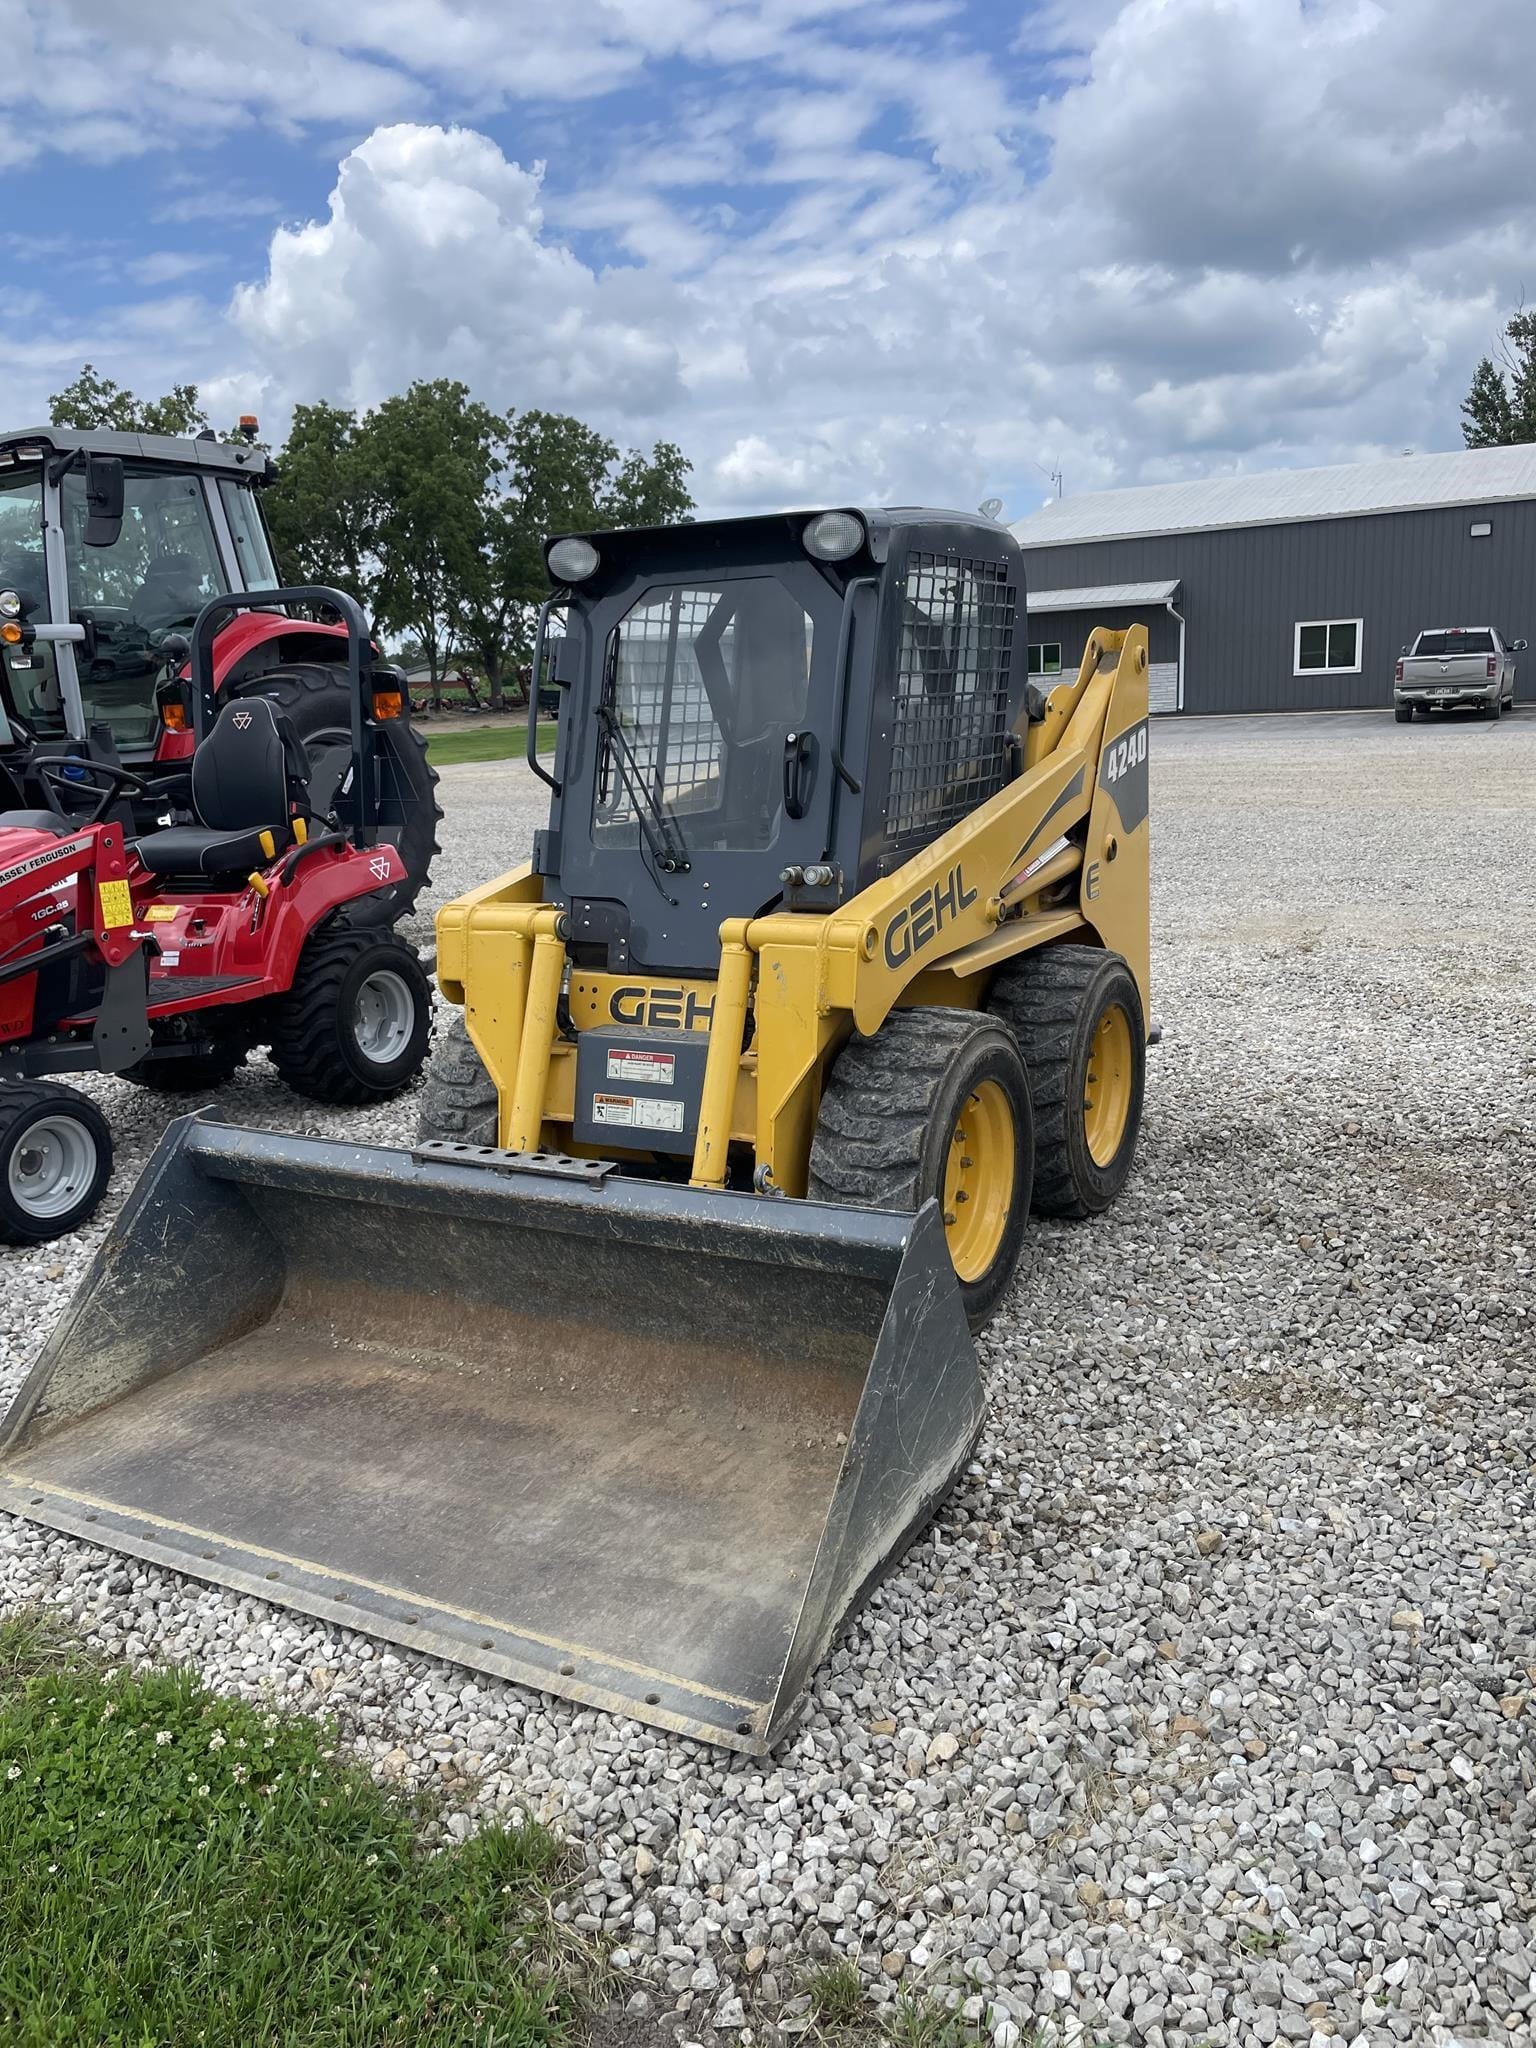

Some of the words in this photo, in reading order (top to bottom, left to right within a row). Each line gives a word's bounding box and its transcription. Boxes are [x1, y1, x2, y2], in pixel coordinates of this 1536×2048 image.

[1108, 727, 1147, 783] 4240
[0, 864, 27, 884] ASSEY
[30, 844, 76, 869] FERGUSON
[884, 861, 978, 970] GEHL
[1, 1020, 25, 1034] WD
[609, 987, 717, 1031] GEH
